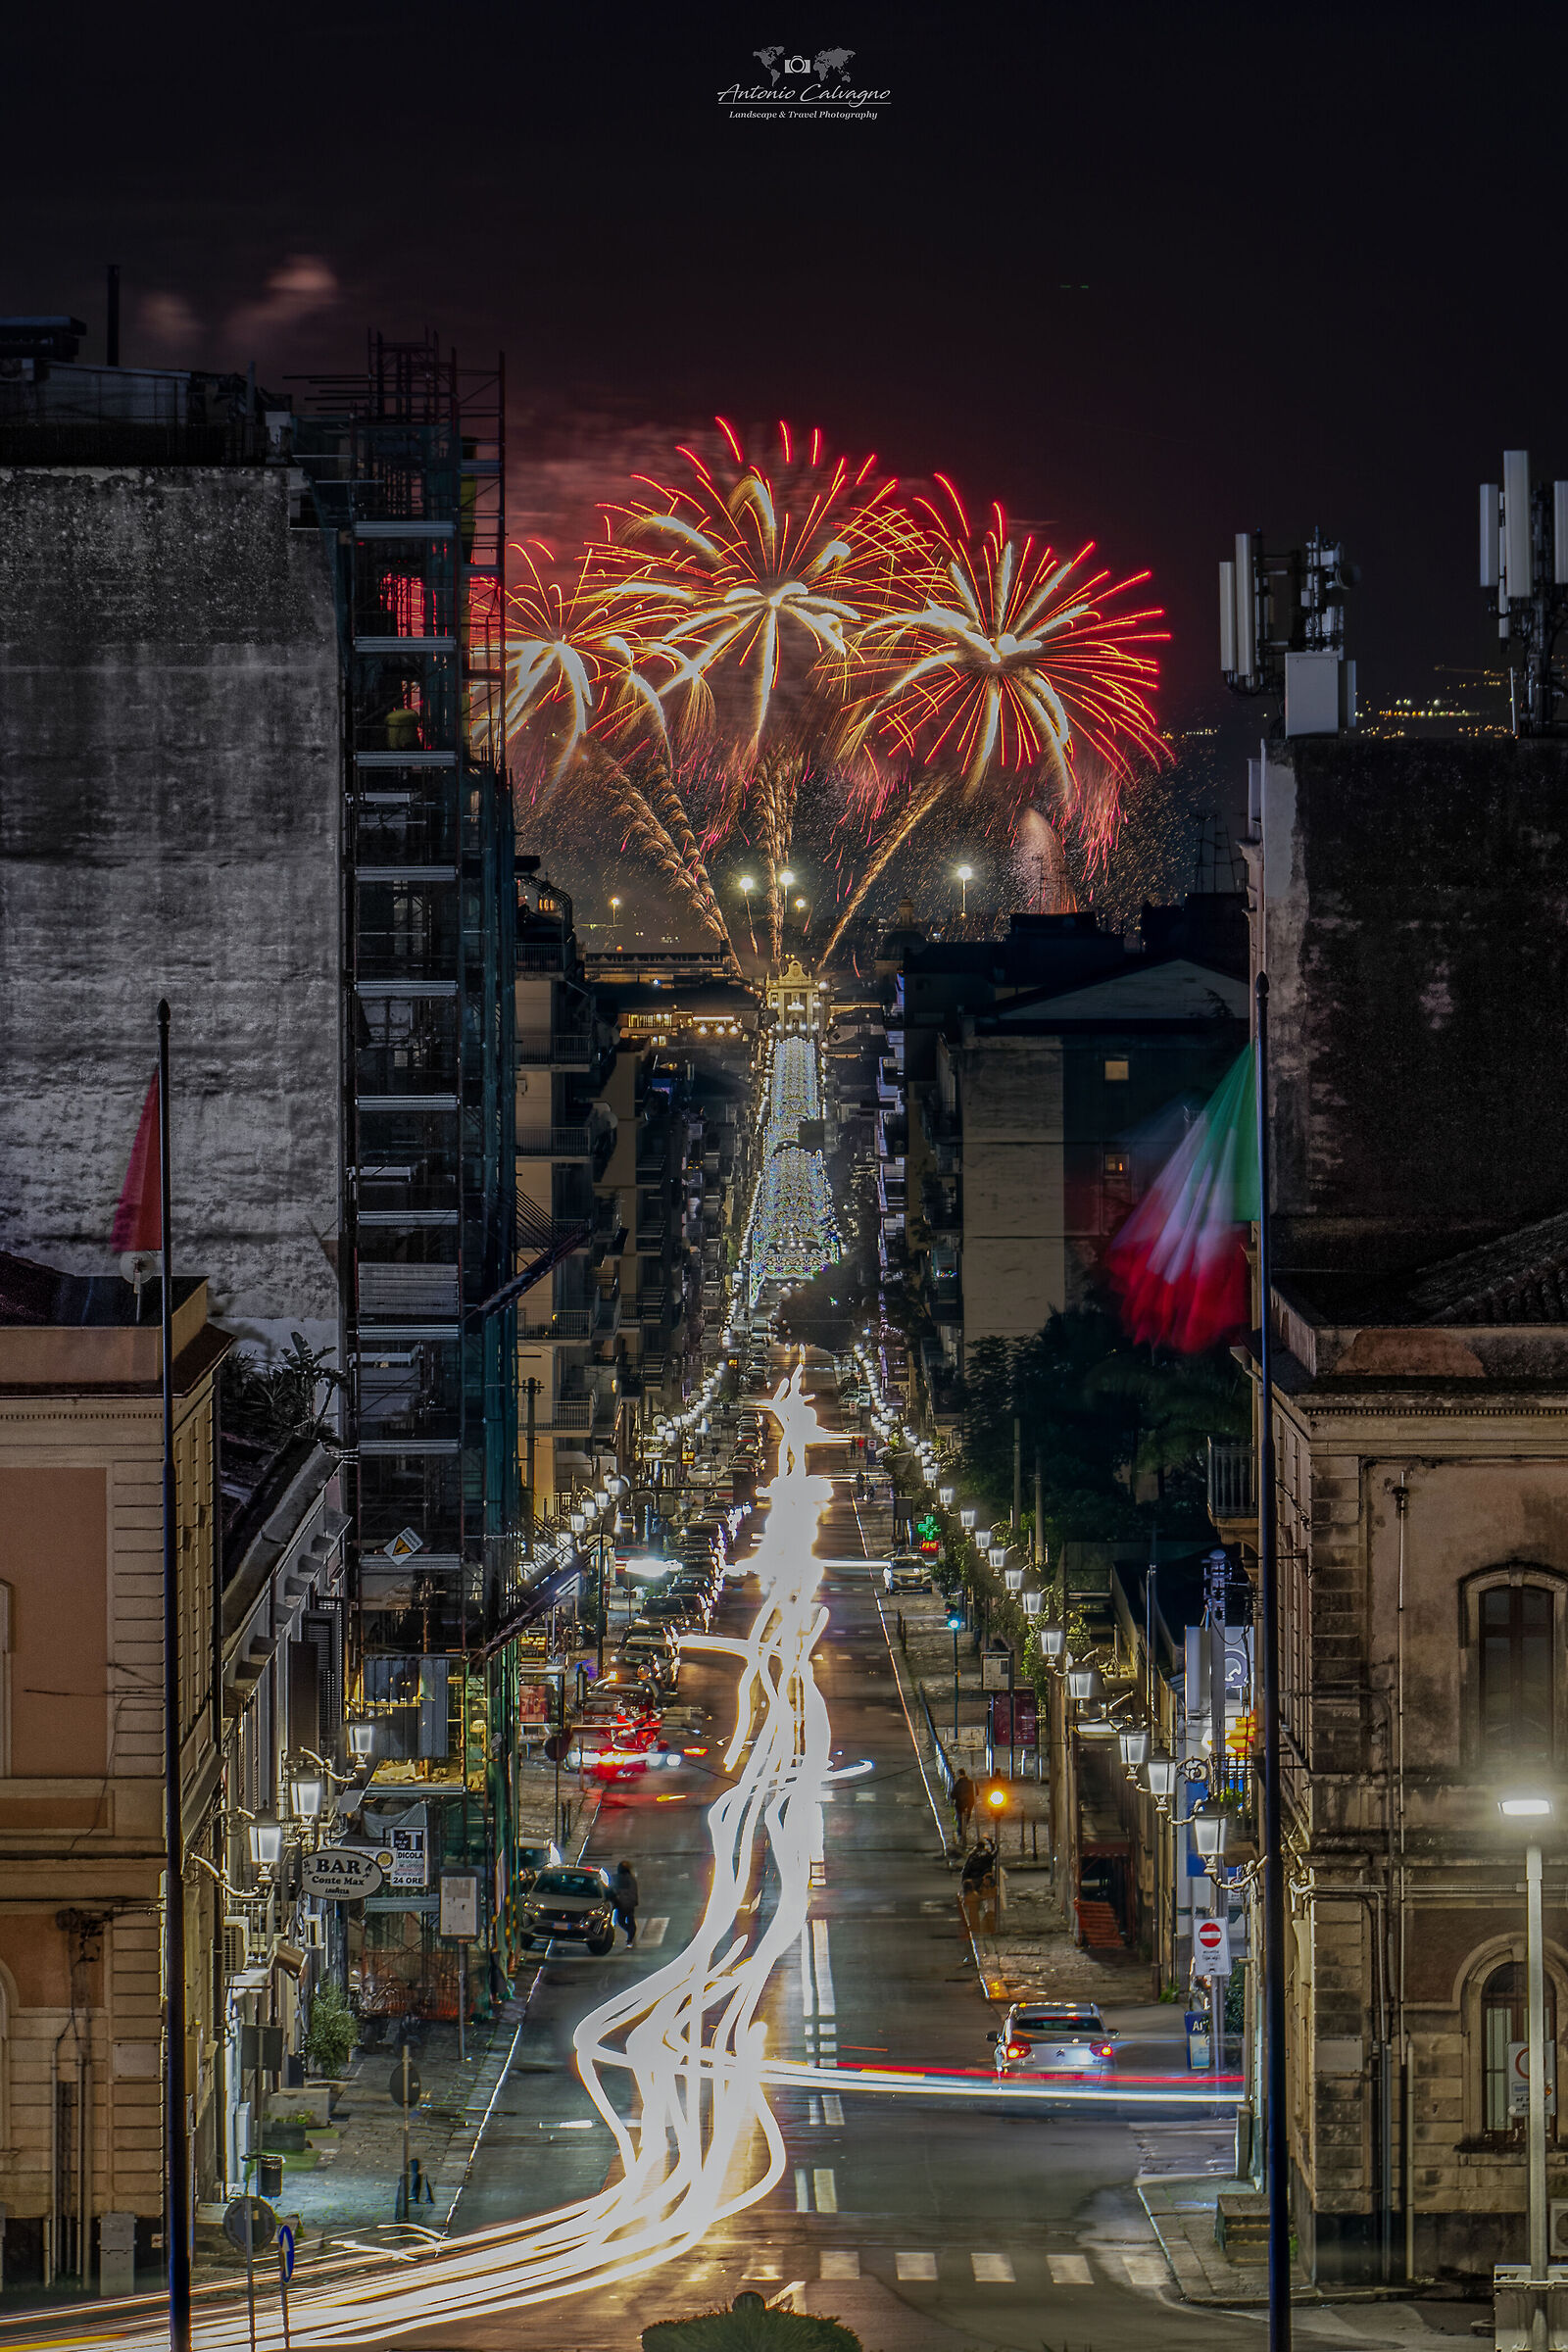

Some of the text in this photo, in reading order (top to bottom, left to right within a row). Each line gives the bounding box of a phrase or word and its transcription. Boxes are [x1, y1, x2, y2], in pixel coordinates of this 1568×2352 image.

[405, 1831, 422, 1850] T
[316, 1858, 362, 1875] BAR
[312, 1875, 365, 1886] Conte Max
